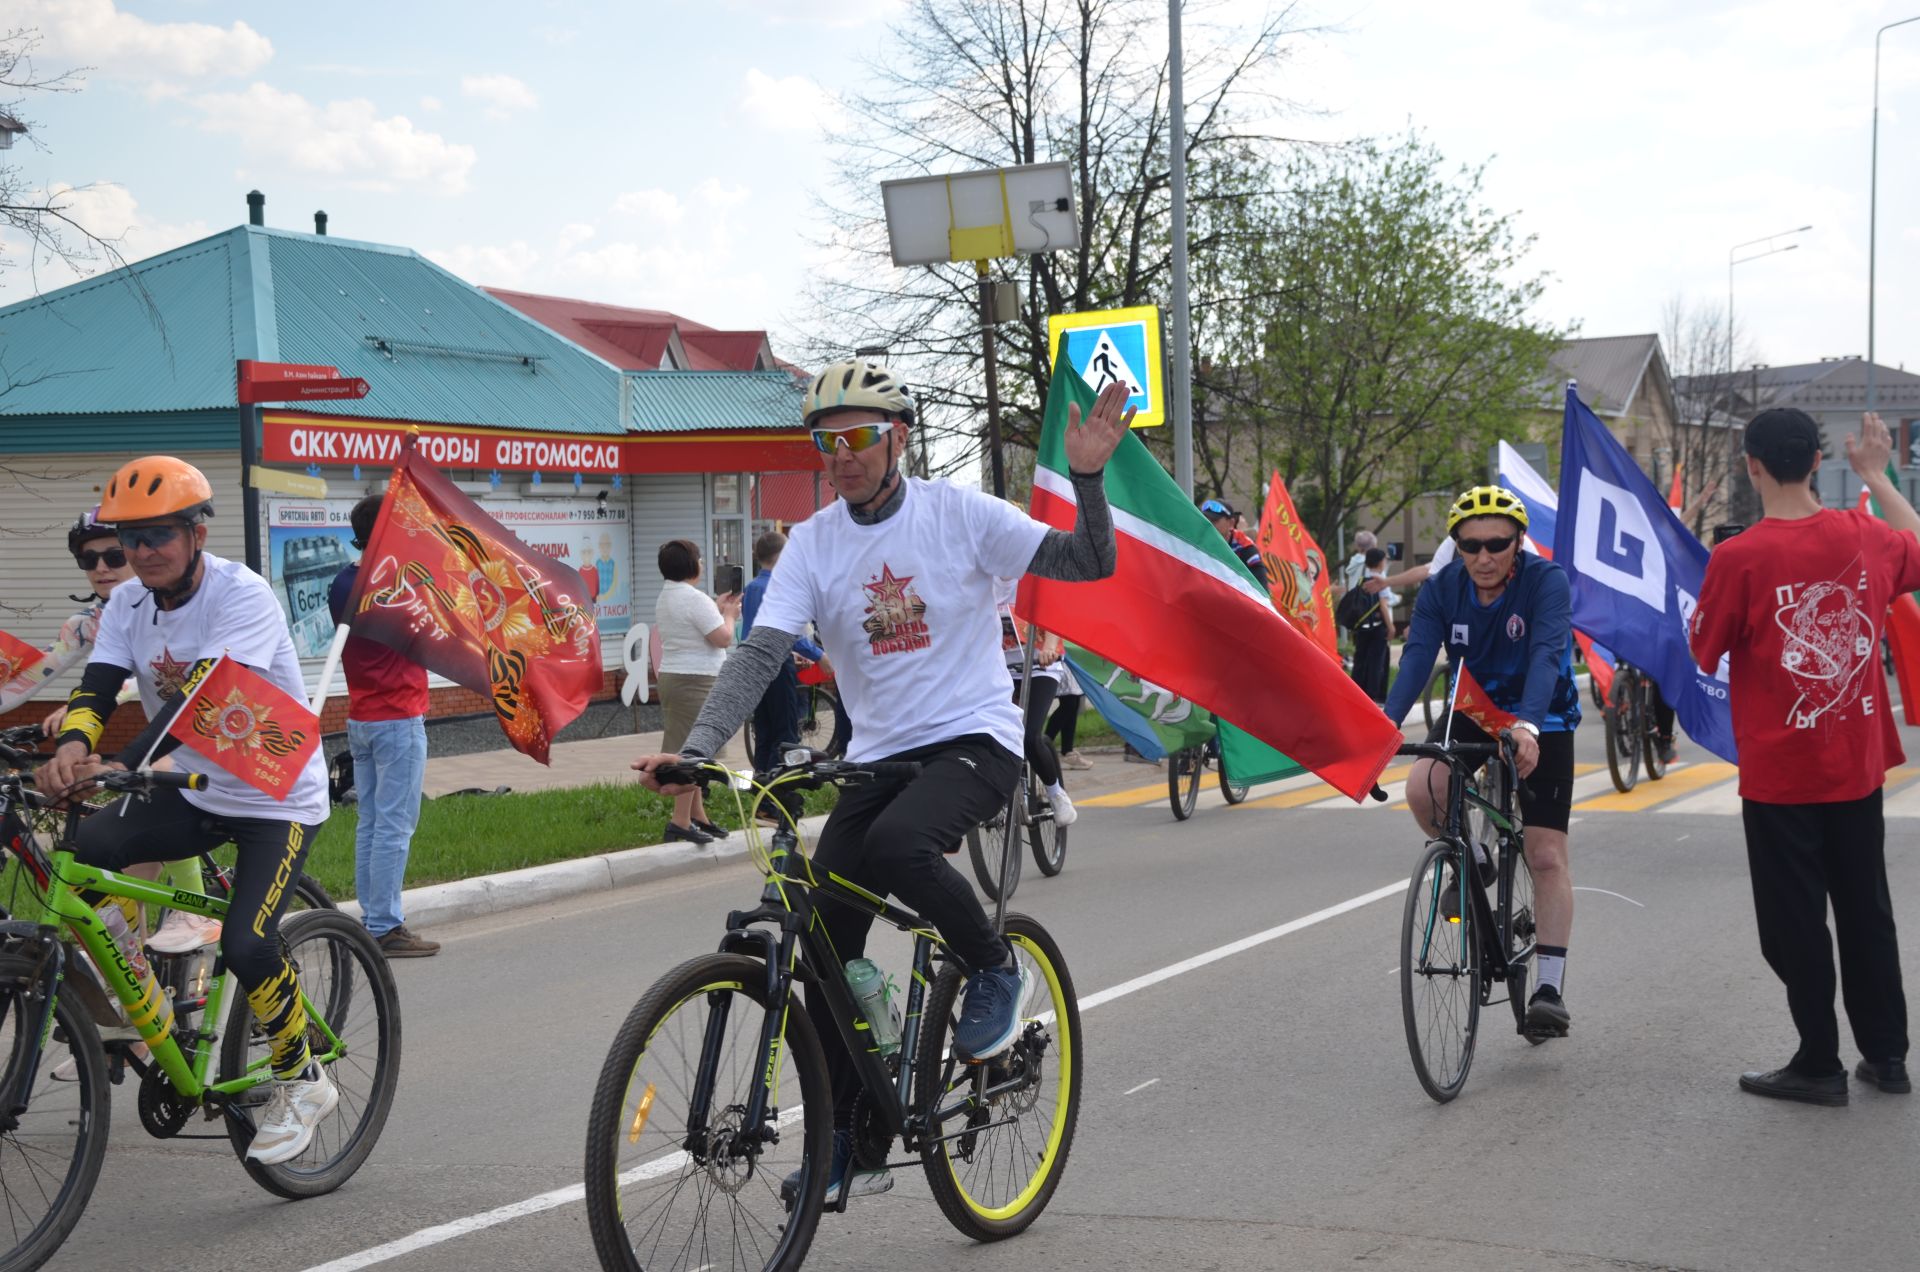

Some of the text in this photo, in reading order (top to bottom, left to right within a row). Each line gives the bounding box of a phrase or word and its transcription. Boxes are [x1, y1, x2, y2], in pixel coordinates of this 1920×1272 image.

[290, 429, 619, 469] аккумулторы автомасла
[604, 604, 628, 617] ТАКСИ
[253, 767, 282, 787] 1945
[175, 891, 206, 908] CRANK
